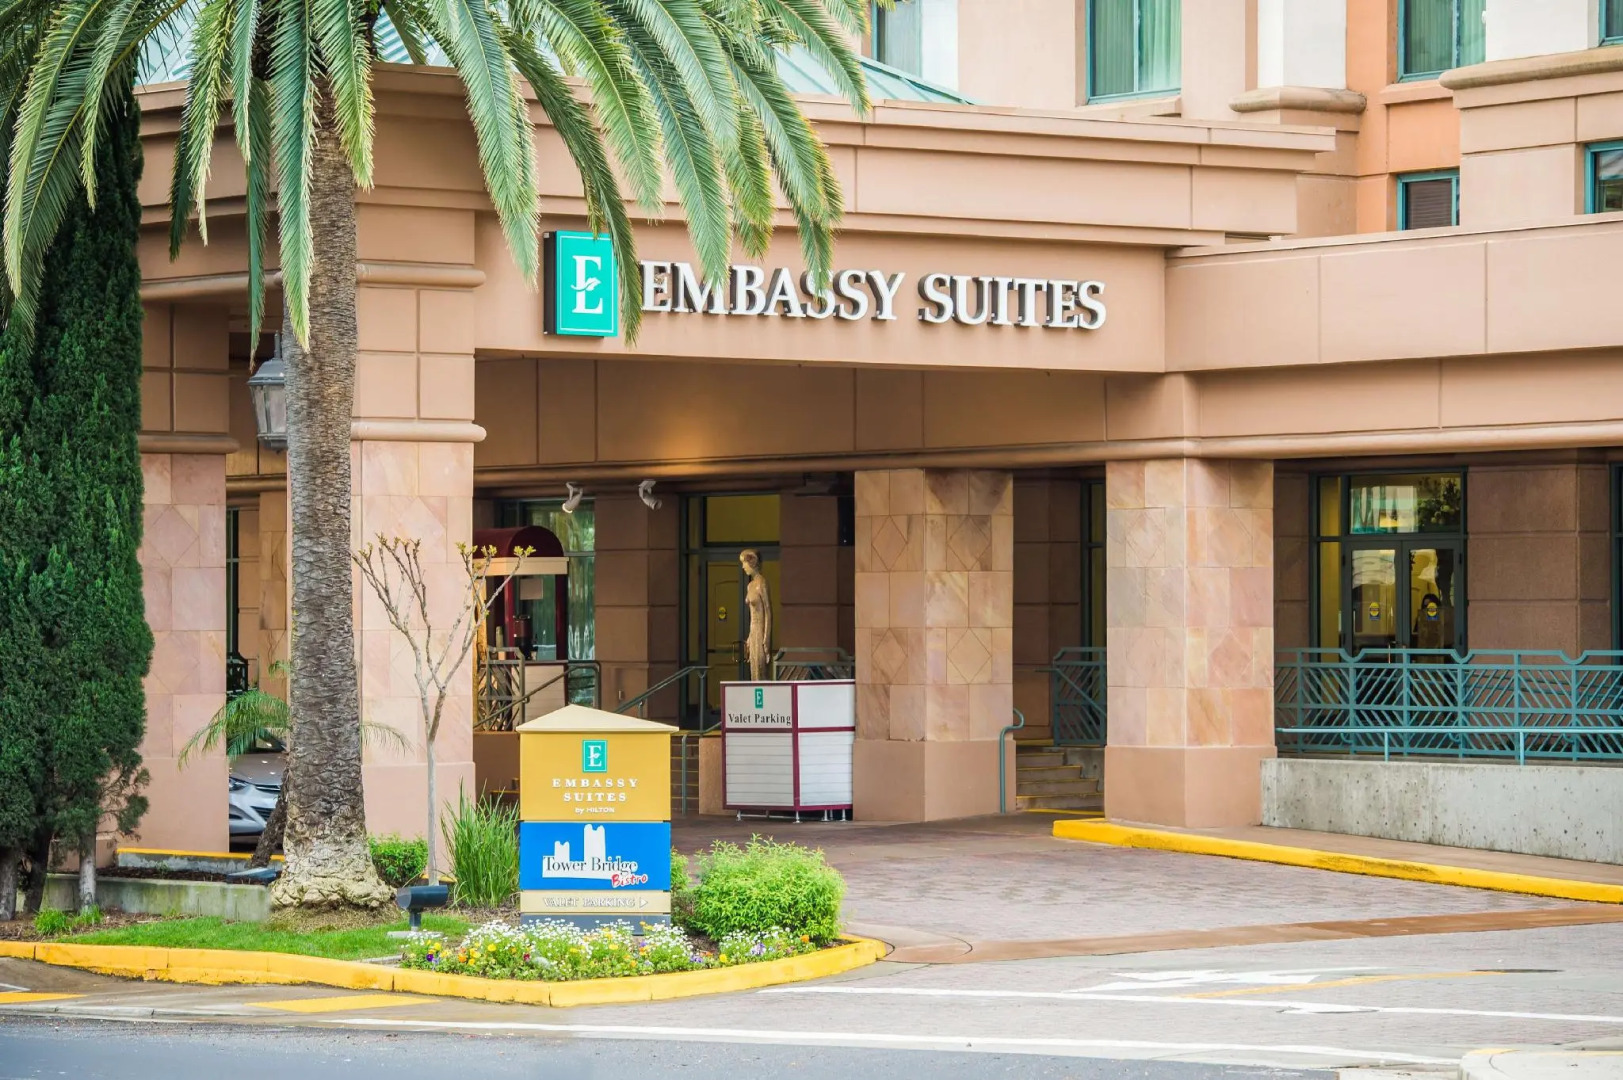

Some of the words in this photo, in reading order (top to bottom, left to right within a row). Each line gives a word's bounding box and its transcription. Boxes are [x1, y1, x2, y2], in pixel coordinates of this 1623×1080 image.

[640, 260, 906, 321] EMBASSY
[918, 273, 1107, 330] SUITES
[728, 713, 751, 723] Valet
[754, 713, 791, 725] Parking
[552, 778, 638, 788] EMBASSY
[563, 792, 627, 802] SUITES
[543, 856, 587, 871] Tower
[591, 856, 638, 875] Bridge
[611, 874, 648, 887] Bistro
[543, 897, 579, 907] VALET
[583, 897, 635, 907] PARKING
